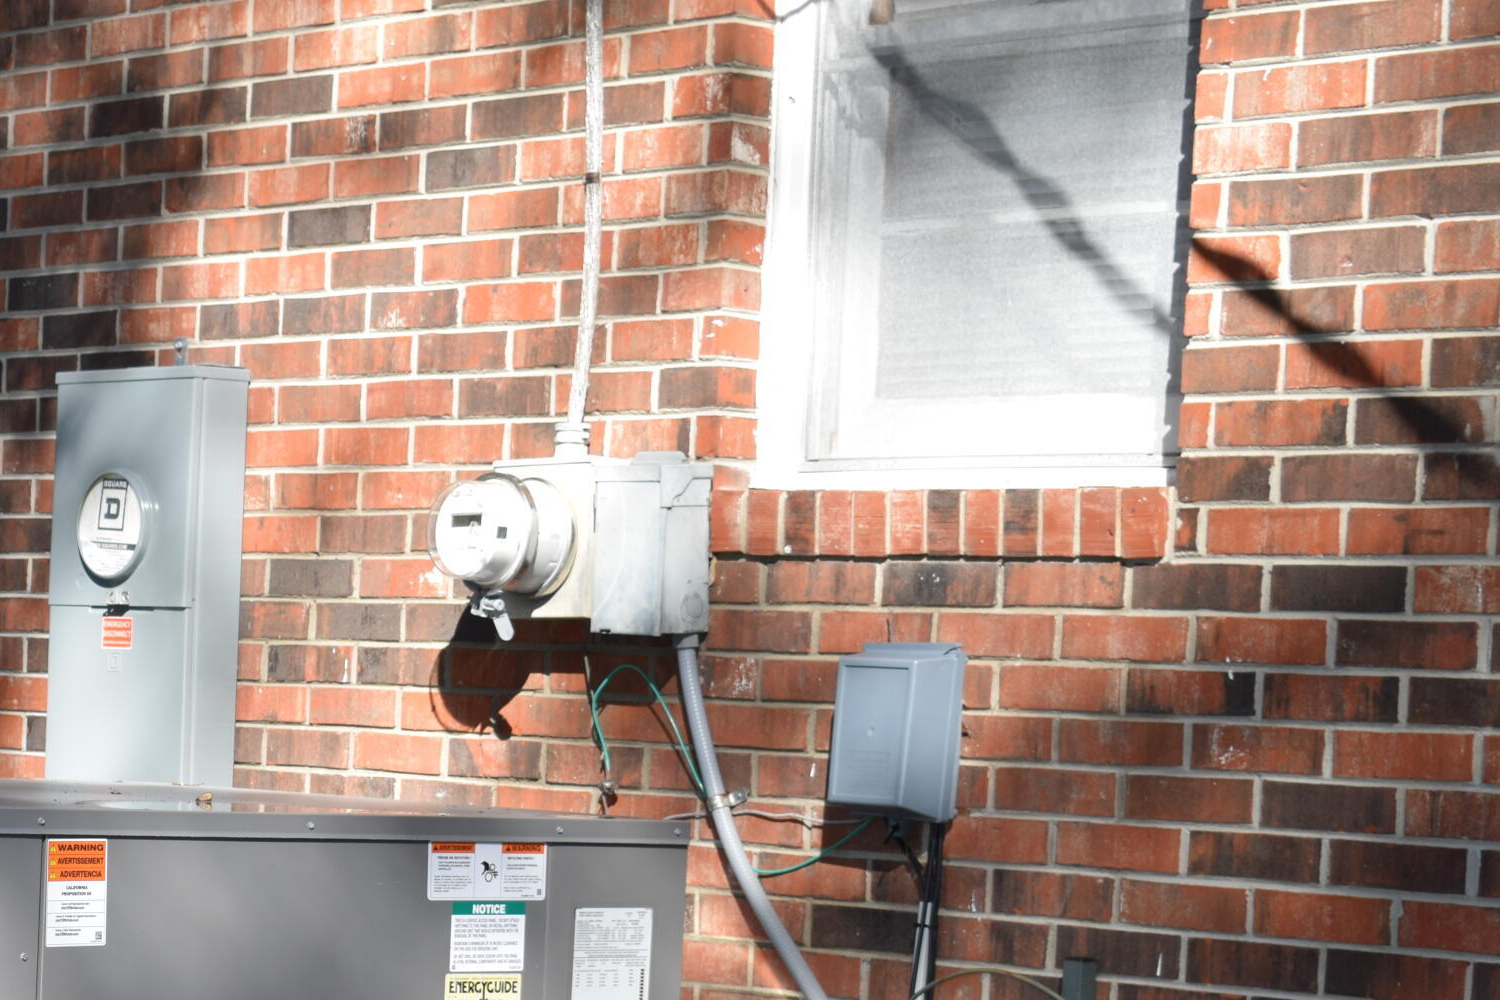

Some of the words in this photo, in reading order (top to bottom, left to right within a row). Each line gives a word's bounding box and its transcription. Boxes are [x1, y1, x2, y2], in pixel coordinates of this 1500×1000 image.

[103, 480, 127, 488] SQUARE
[104, 497, 120, 520] D
[57, 844, 104, 852] WARNING
[511, 843, 540, 852] WARNING
[57, 857, 104, 865] AVERTISSEMENT
[59, 870, 102, 878] ADVERTENCIA
[472, 904, 506, 914] NOTICE
